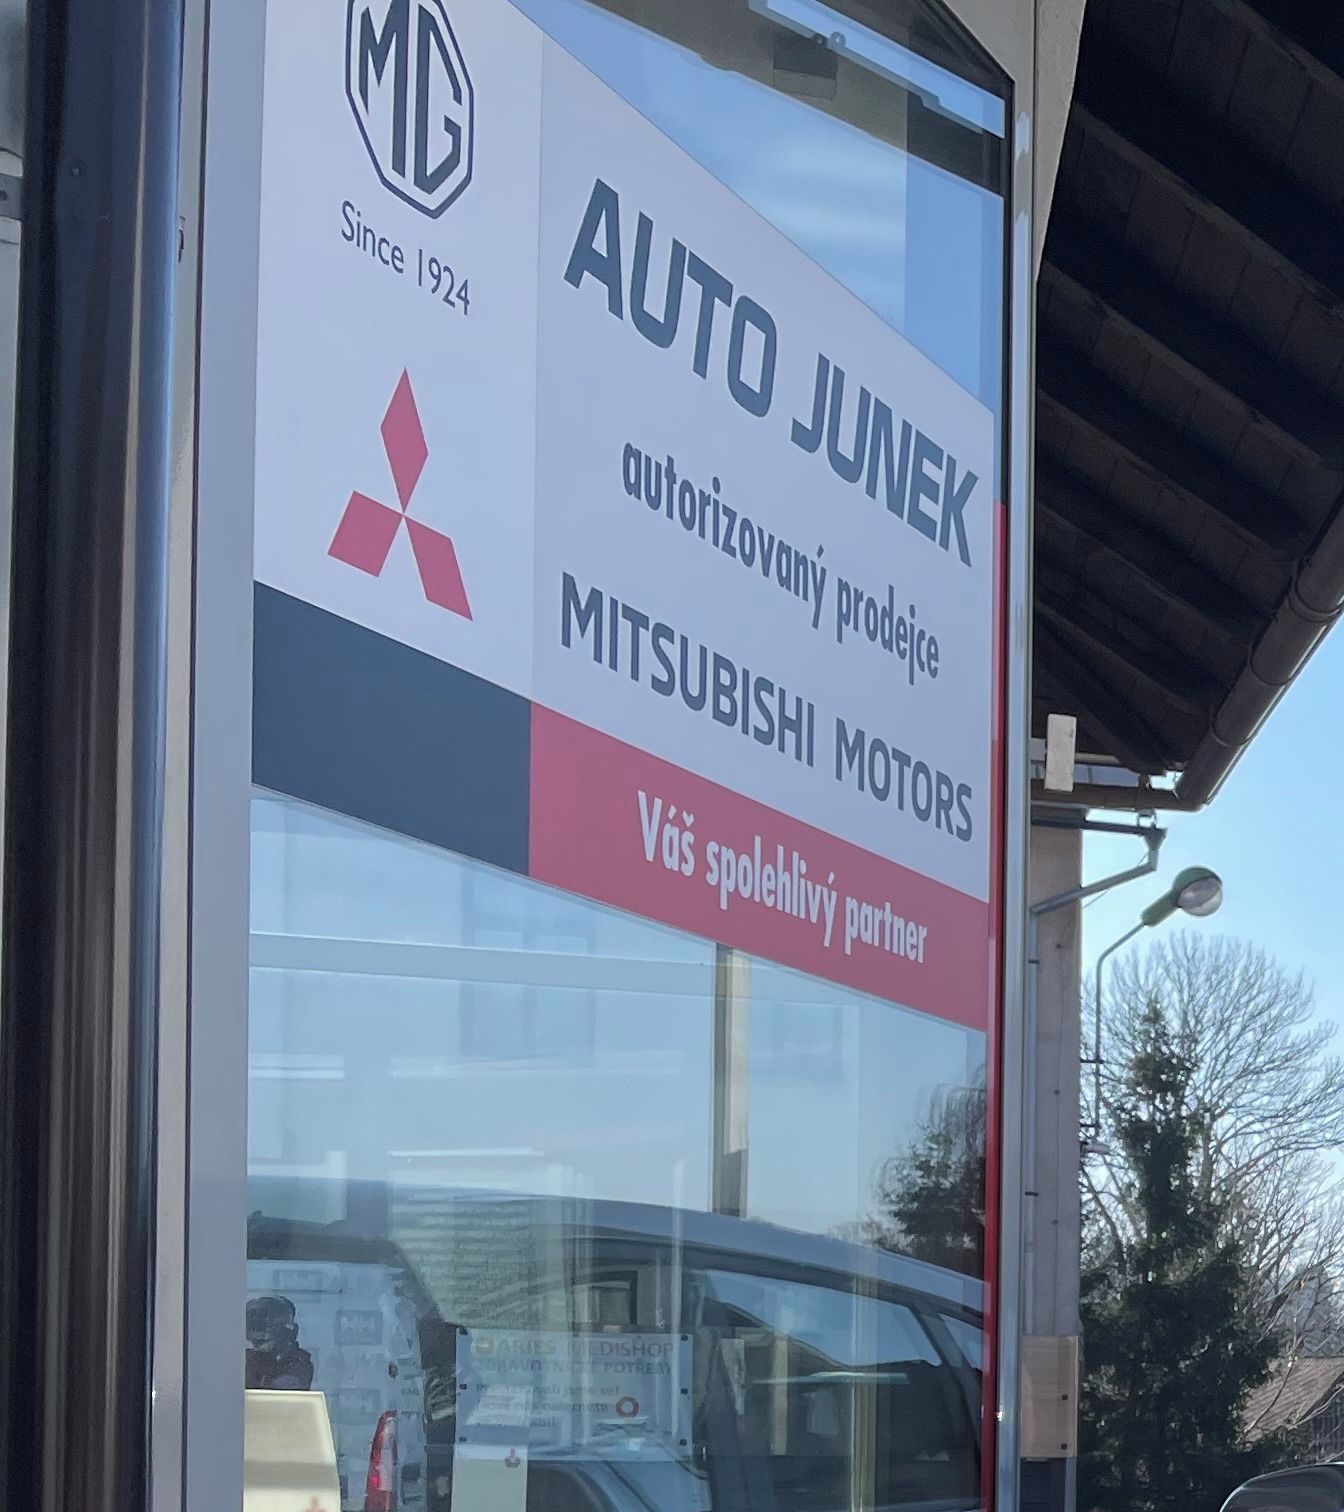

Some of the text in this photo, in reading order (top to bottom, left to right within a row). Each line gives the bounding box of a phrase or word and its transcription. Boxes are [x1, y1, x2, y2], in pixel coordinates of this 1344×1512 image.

[341, 200, 470, 316] Since 1924
[563, 177, 979, 568] AUTO JUNEK
[622, 439, 940, 685] autorizovaný prodejce
[561, 572, 973, 843] MITSUBISHI MOTORS
[638, 790, 928, 963] Váš spolehlivý partner
